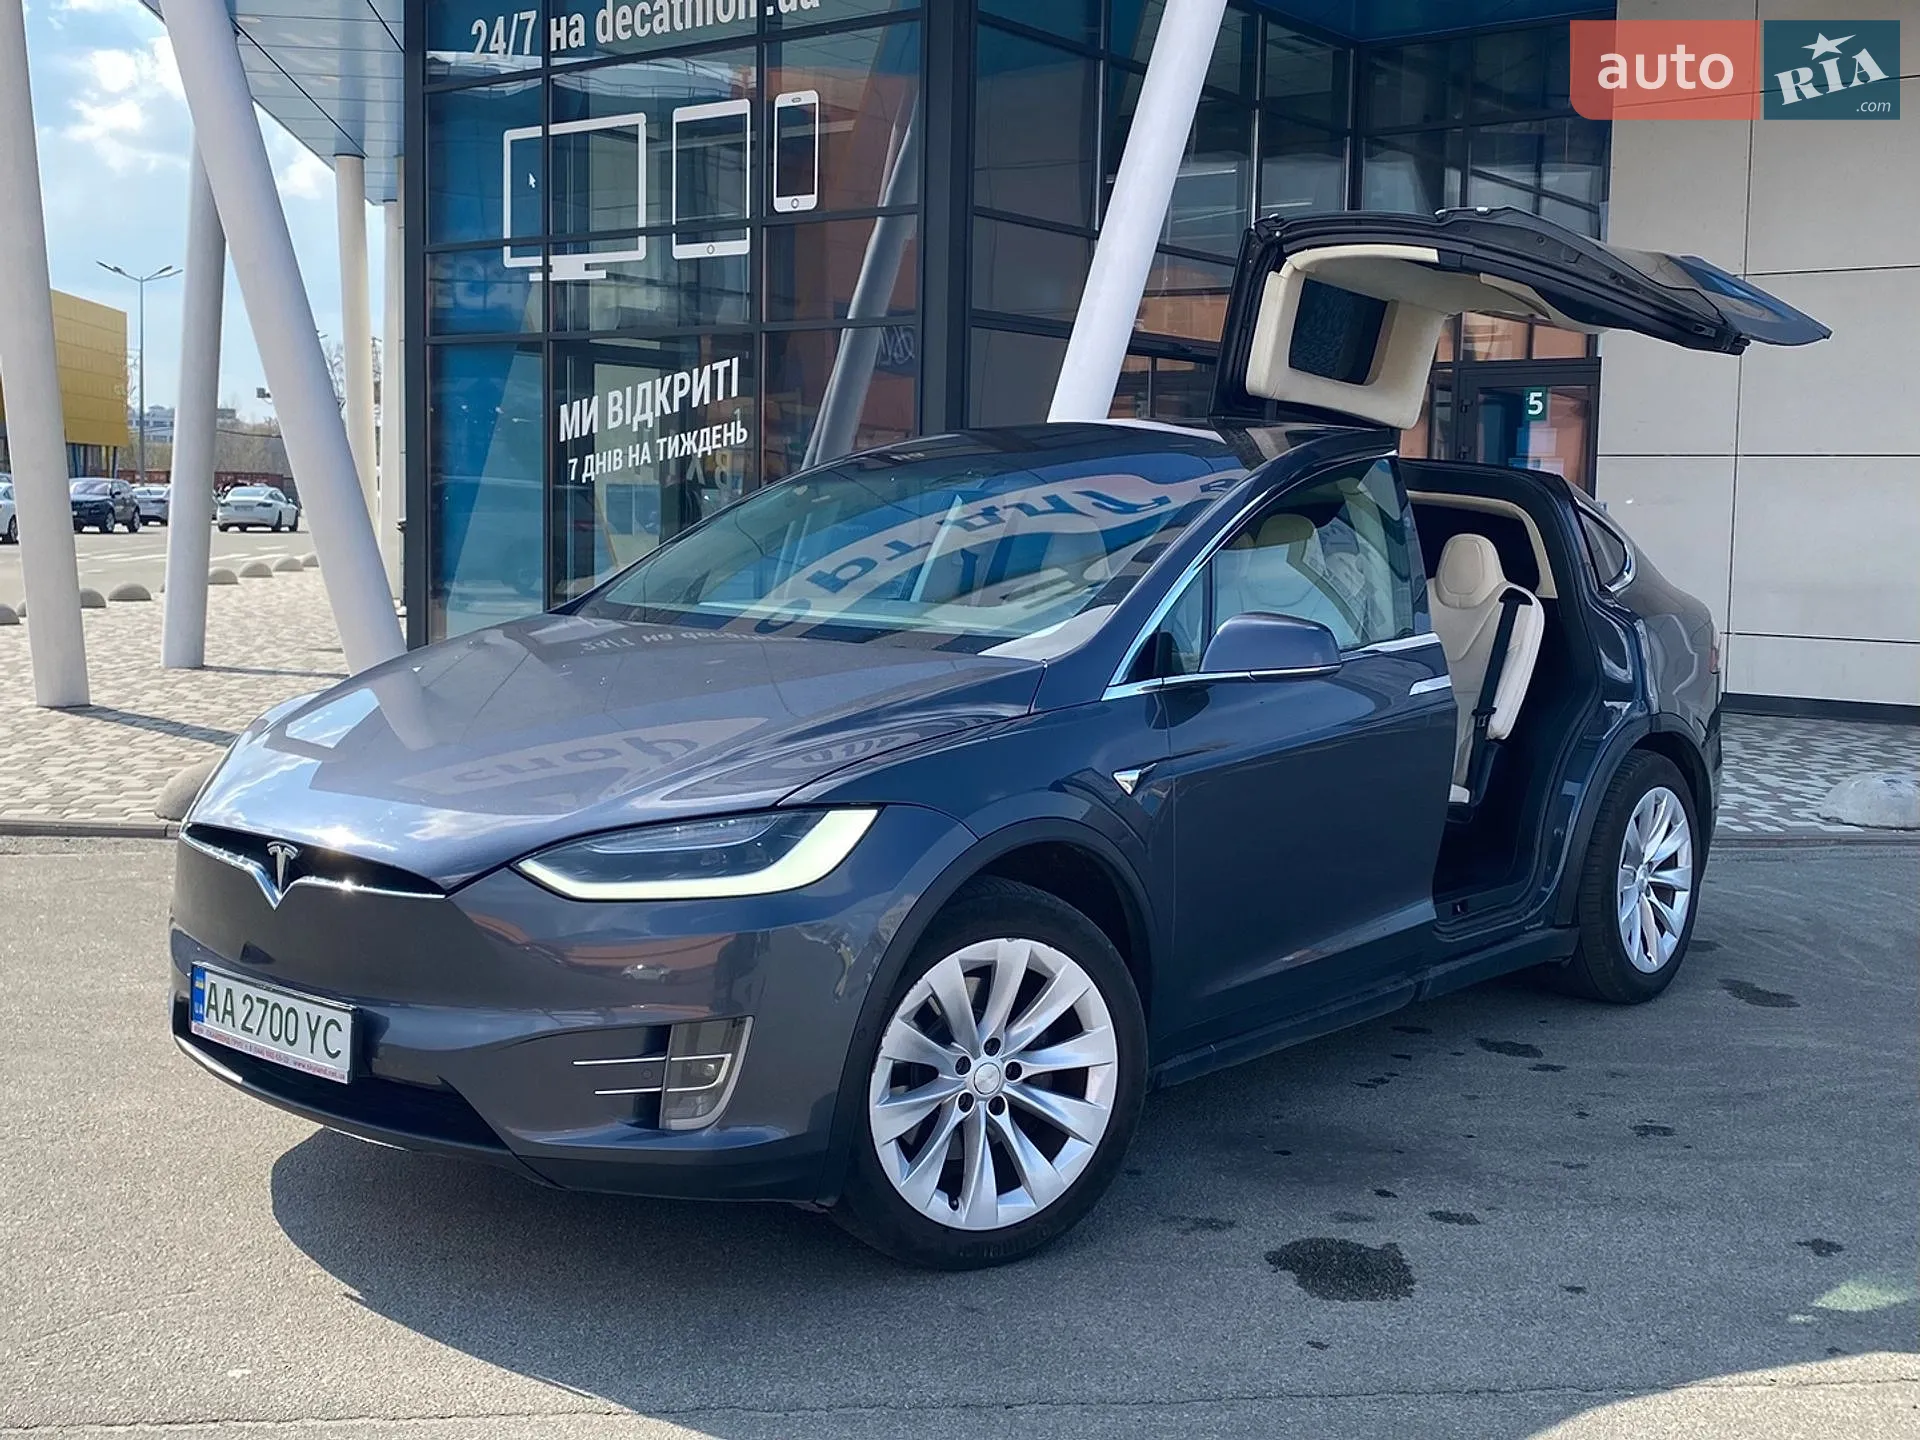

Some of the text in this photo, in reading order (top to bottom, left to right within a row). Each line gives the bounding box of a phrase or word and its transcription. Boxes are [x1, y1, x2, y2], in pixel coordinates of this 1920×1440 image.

[471, 10, 537, 62] 24/7
[550, 12, 586, 51] на
[559, 356, 739, 442] МИ ВІДКРИТІ
[1526, 391, 1544, 415] 5
[567, 457, 579, 481] 7
[581, 448, 623, 484] ДНІВ
[628, 441, 652, 468] НА
[656, 420, 749, 461] ТИЖДЕНЬ
[205, 982, 236, 1029] AA
[240, 993, 299, 1048] 2700
[305, 1011, 343, 1060] YC
